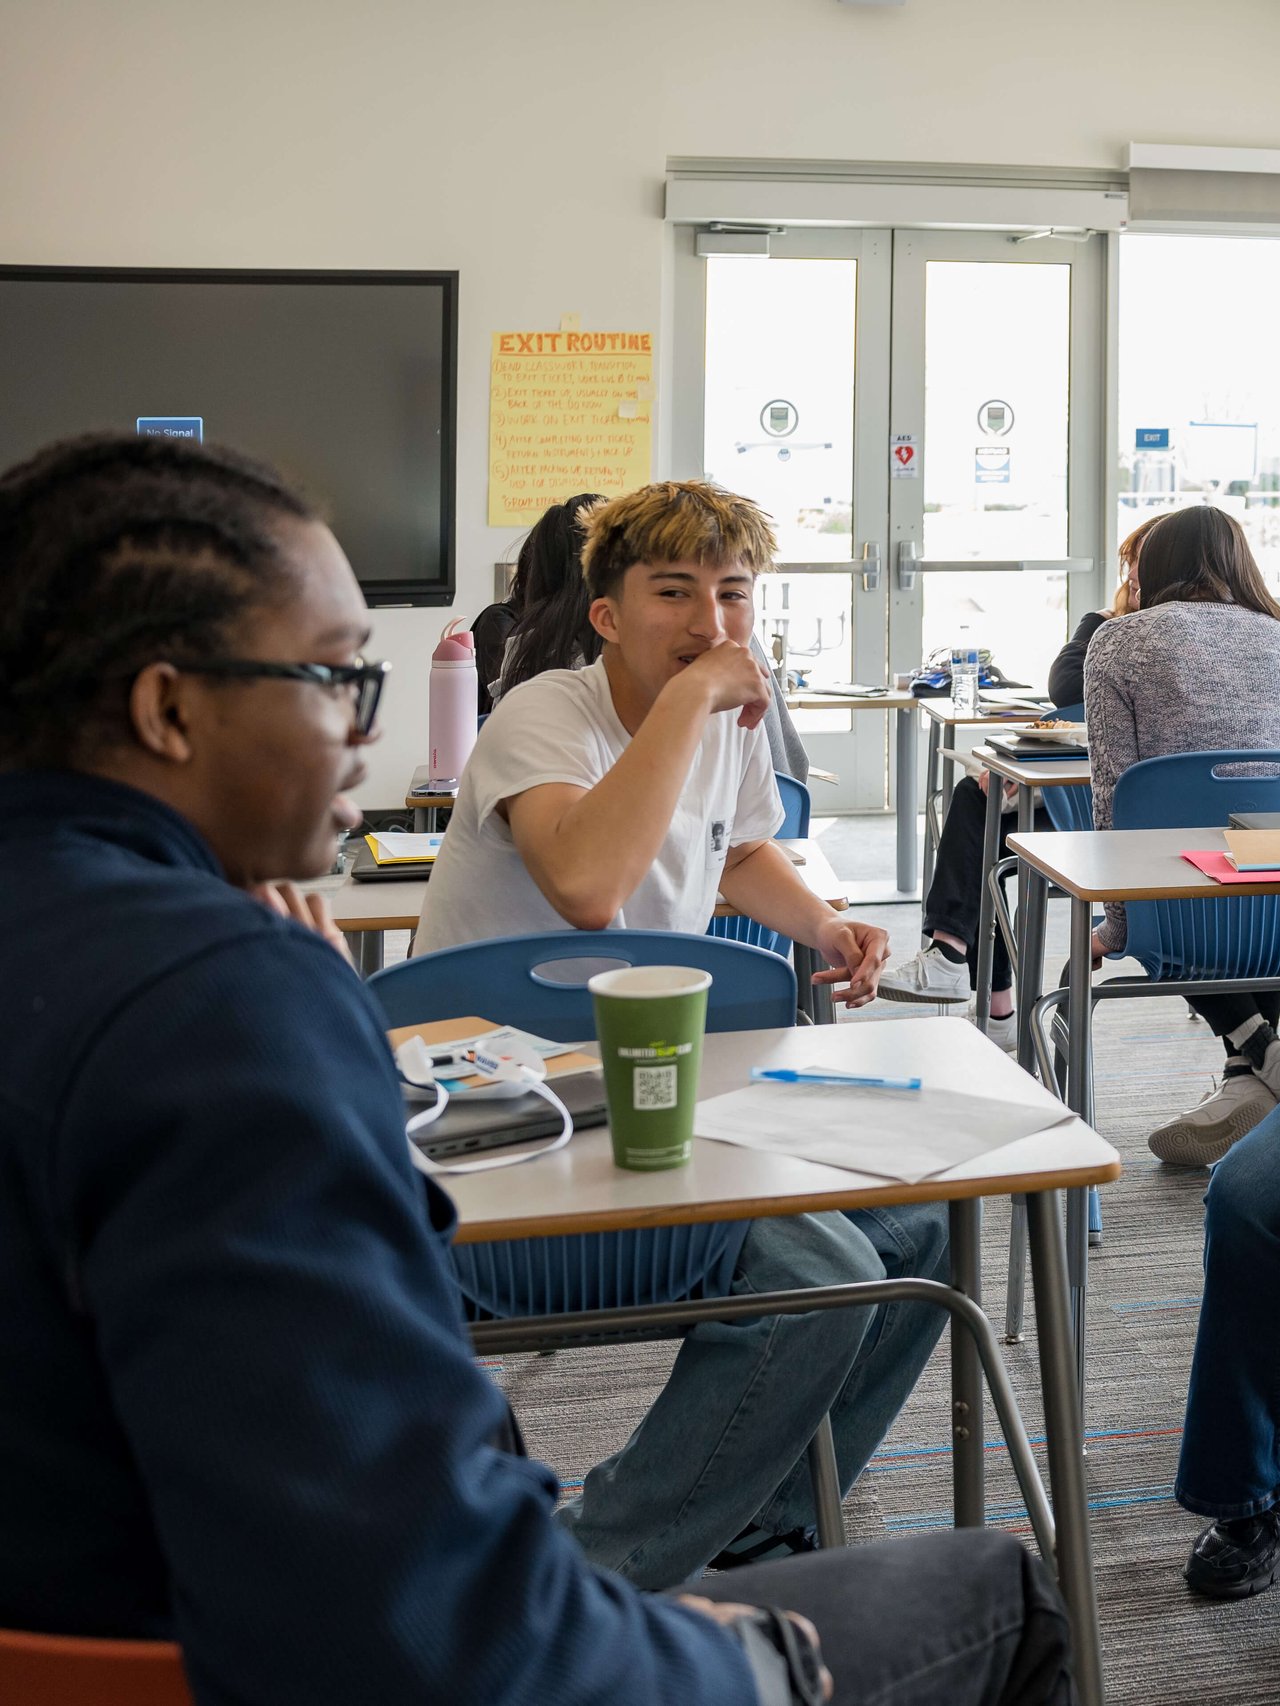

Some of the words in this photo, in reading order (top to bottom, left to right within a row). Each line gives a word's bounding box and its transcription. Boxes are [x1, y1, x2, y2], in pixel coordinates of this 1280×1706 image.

[500, 333, 561, 352] EXIT
[567, 333, 652, 352] ROUTINE
[163, 428, 193, 439] Signal
